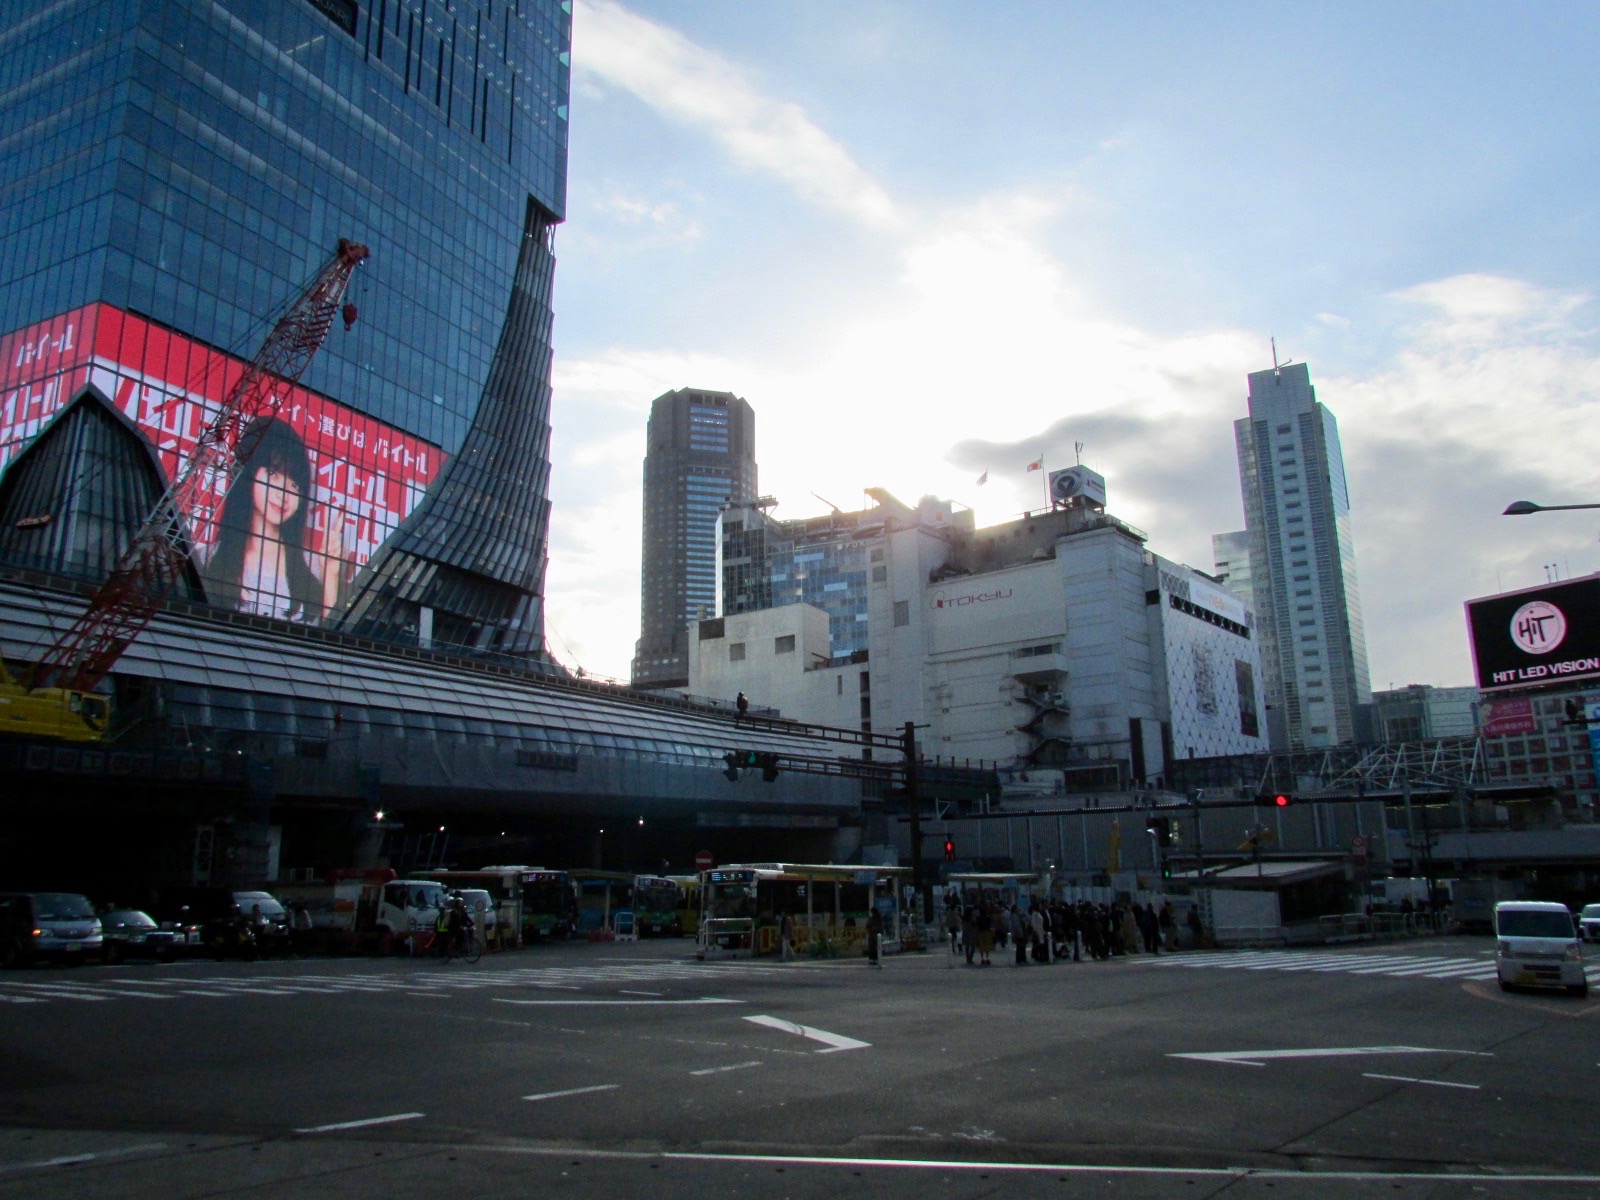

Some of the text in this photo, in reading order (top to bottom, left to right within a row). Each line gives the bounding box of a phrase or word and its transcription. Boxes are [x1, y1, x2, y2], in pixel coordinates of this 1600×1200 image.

[943, 588, 1013, 607] TOKYU
[1493, 657, 1600, 683] HIT LED VISION
